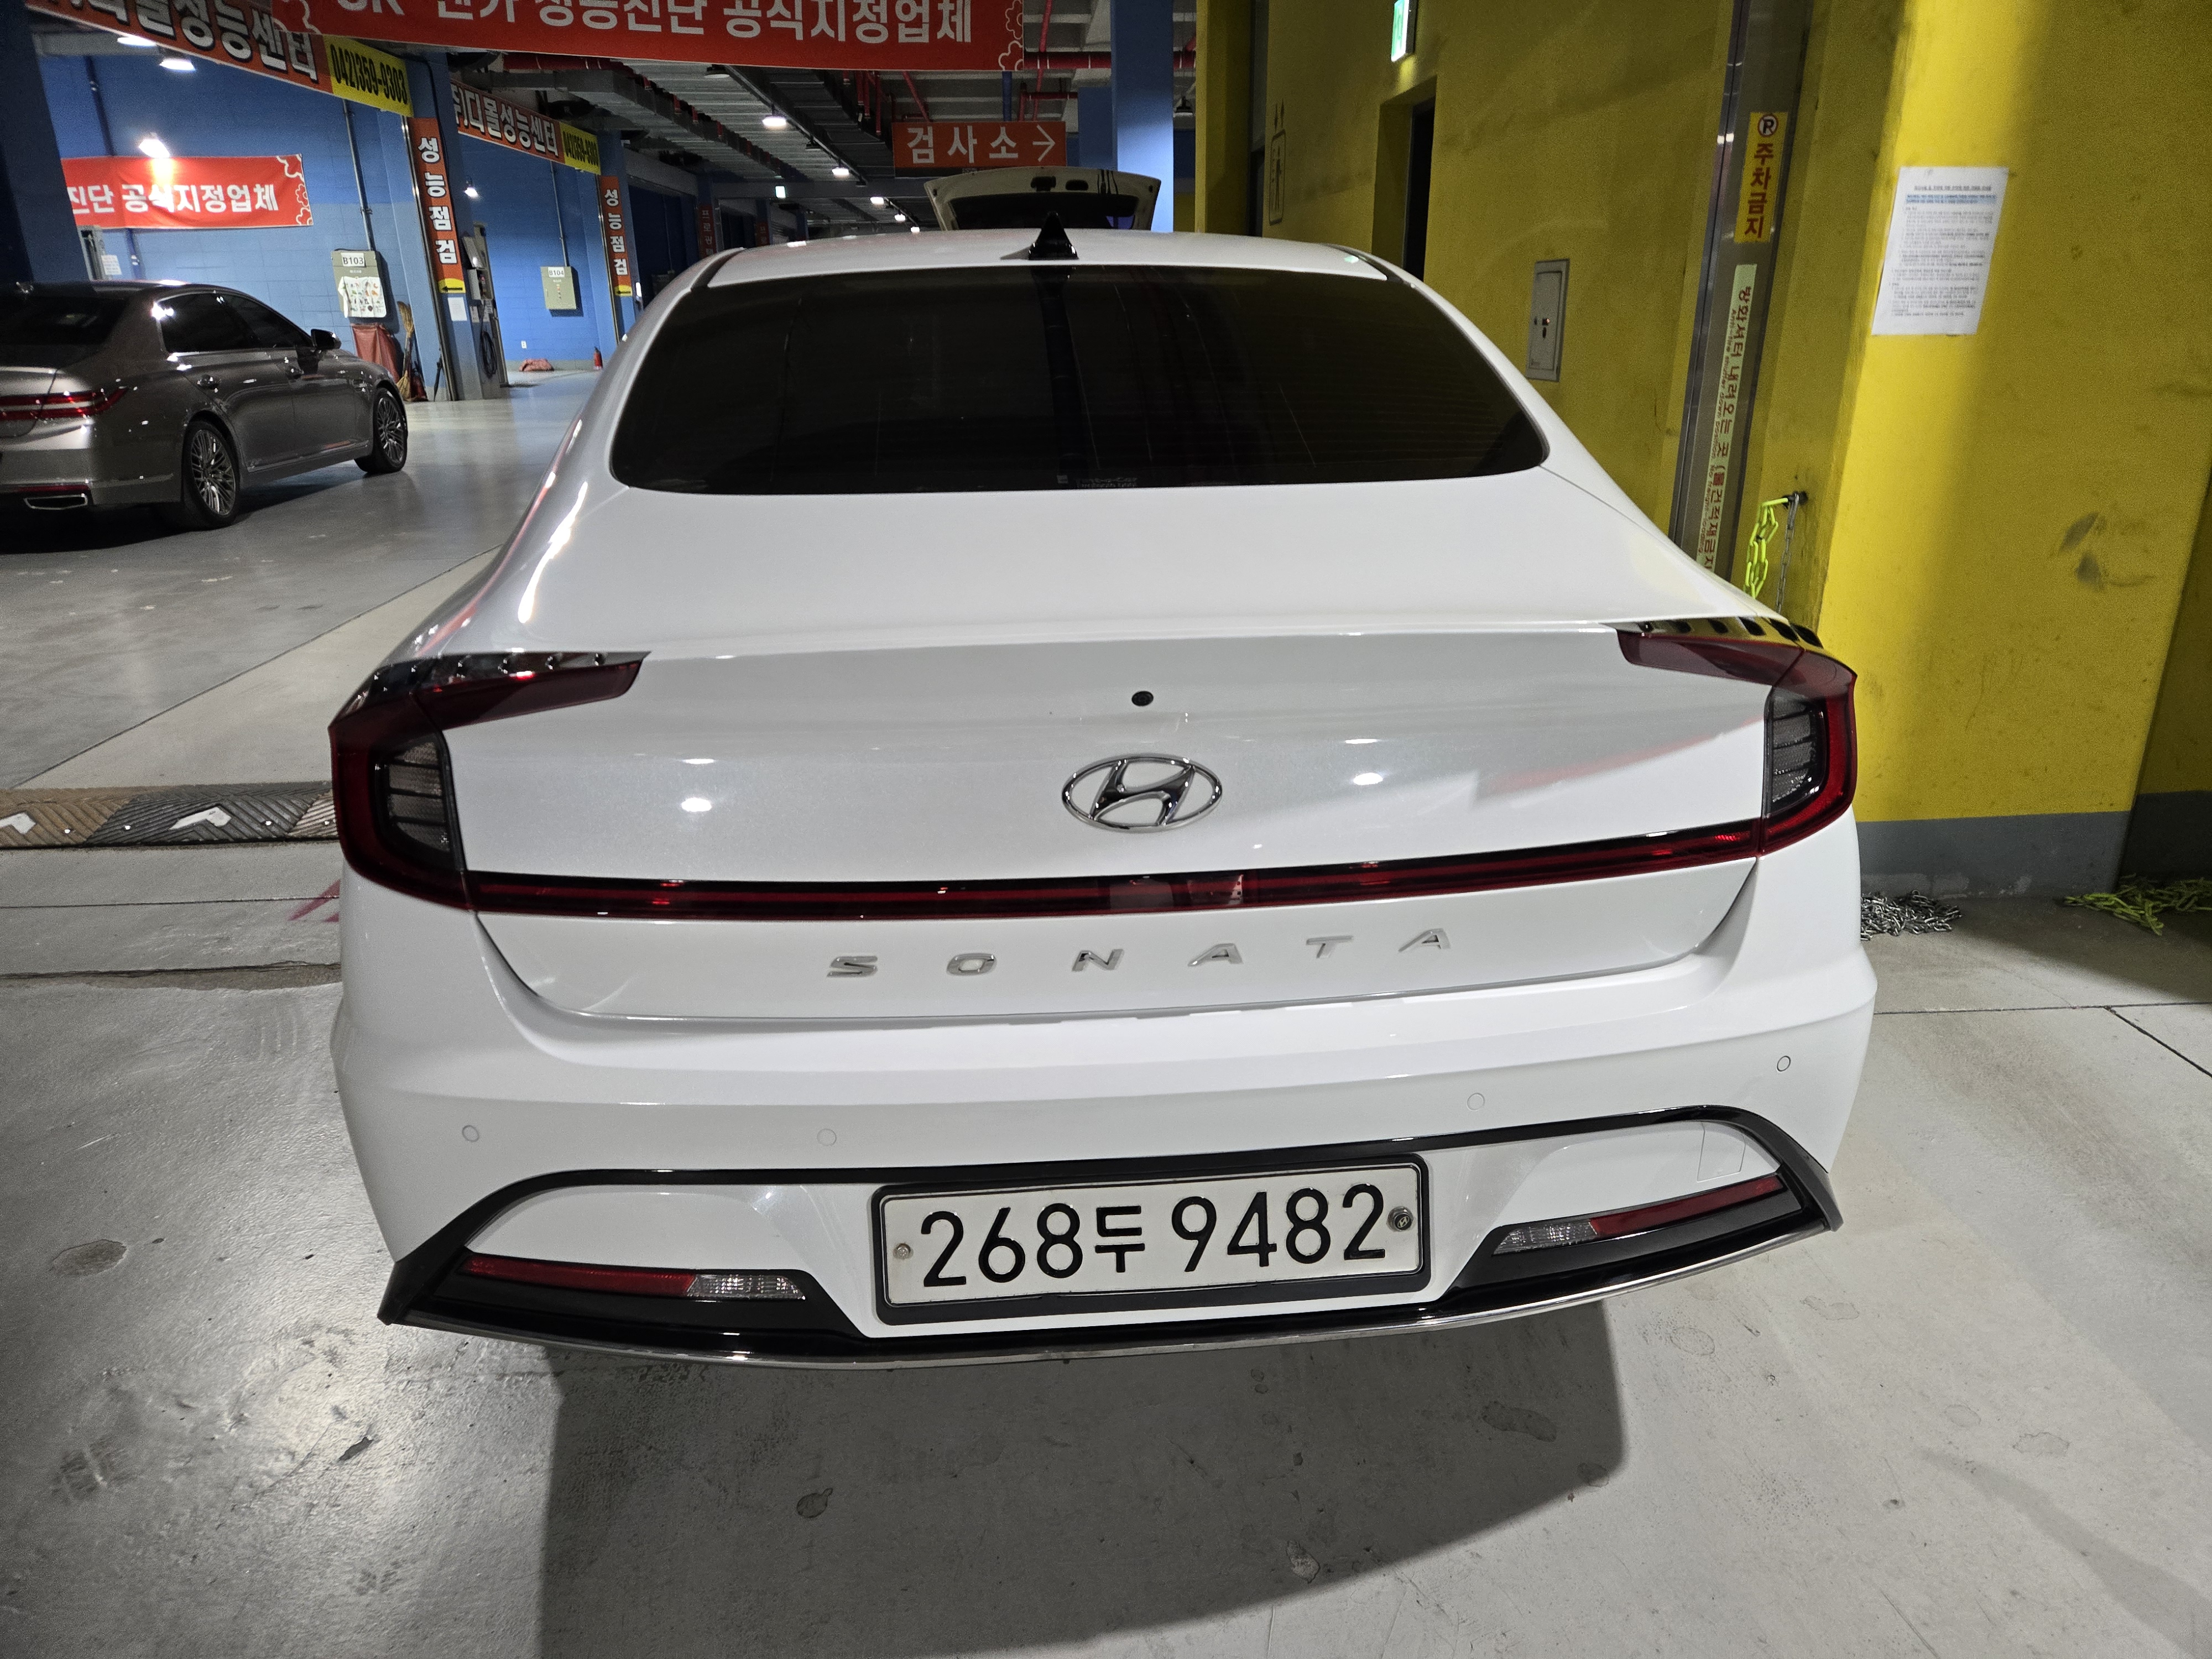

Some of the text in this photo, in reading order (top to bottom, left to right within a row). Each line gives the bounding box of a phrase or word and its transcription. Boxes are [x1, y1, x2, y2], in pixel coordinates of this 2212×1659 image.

[723, 0, 972, 43] 공식지정업체
[907, 125, 1019, 164] 검사소
[67, 184, 279, 214] 진단 공식지정업체
[418, 136, 457, 264] 성능점검
[1744, 143, 1775, 238] 주차금지
[604, 189, 628, 275] 성능점검
[1731, 286, 1752, 357] 방화셔터
[1720, 366, 1740, 434] 내려오는
[1717, 442, 1729, 458] 곳
[826, 928, 1451, 978] SONATA
[921, 1182, 1385, 1287] 268두 9482
